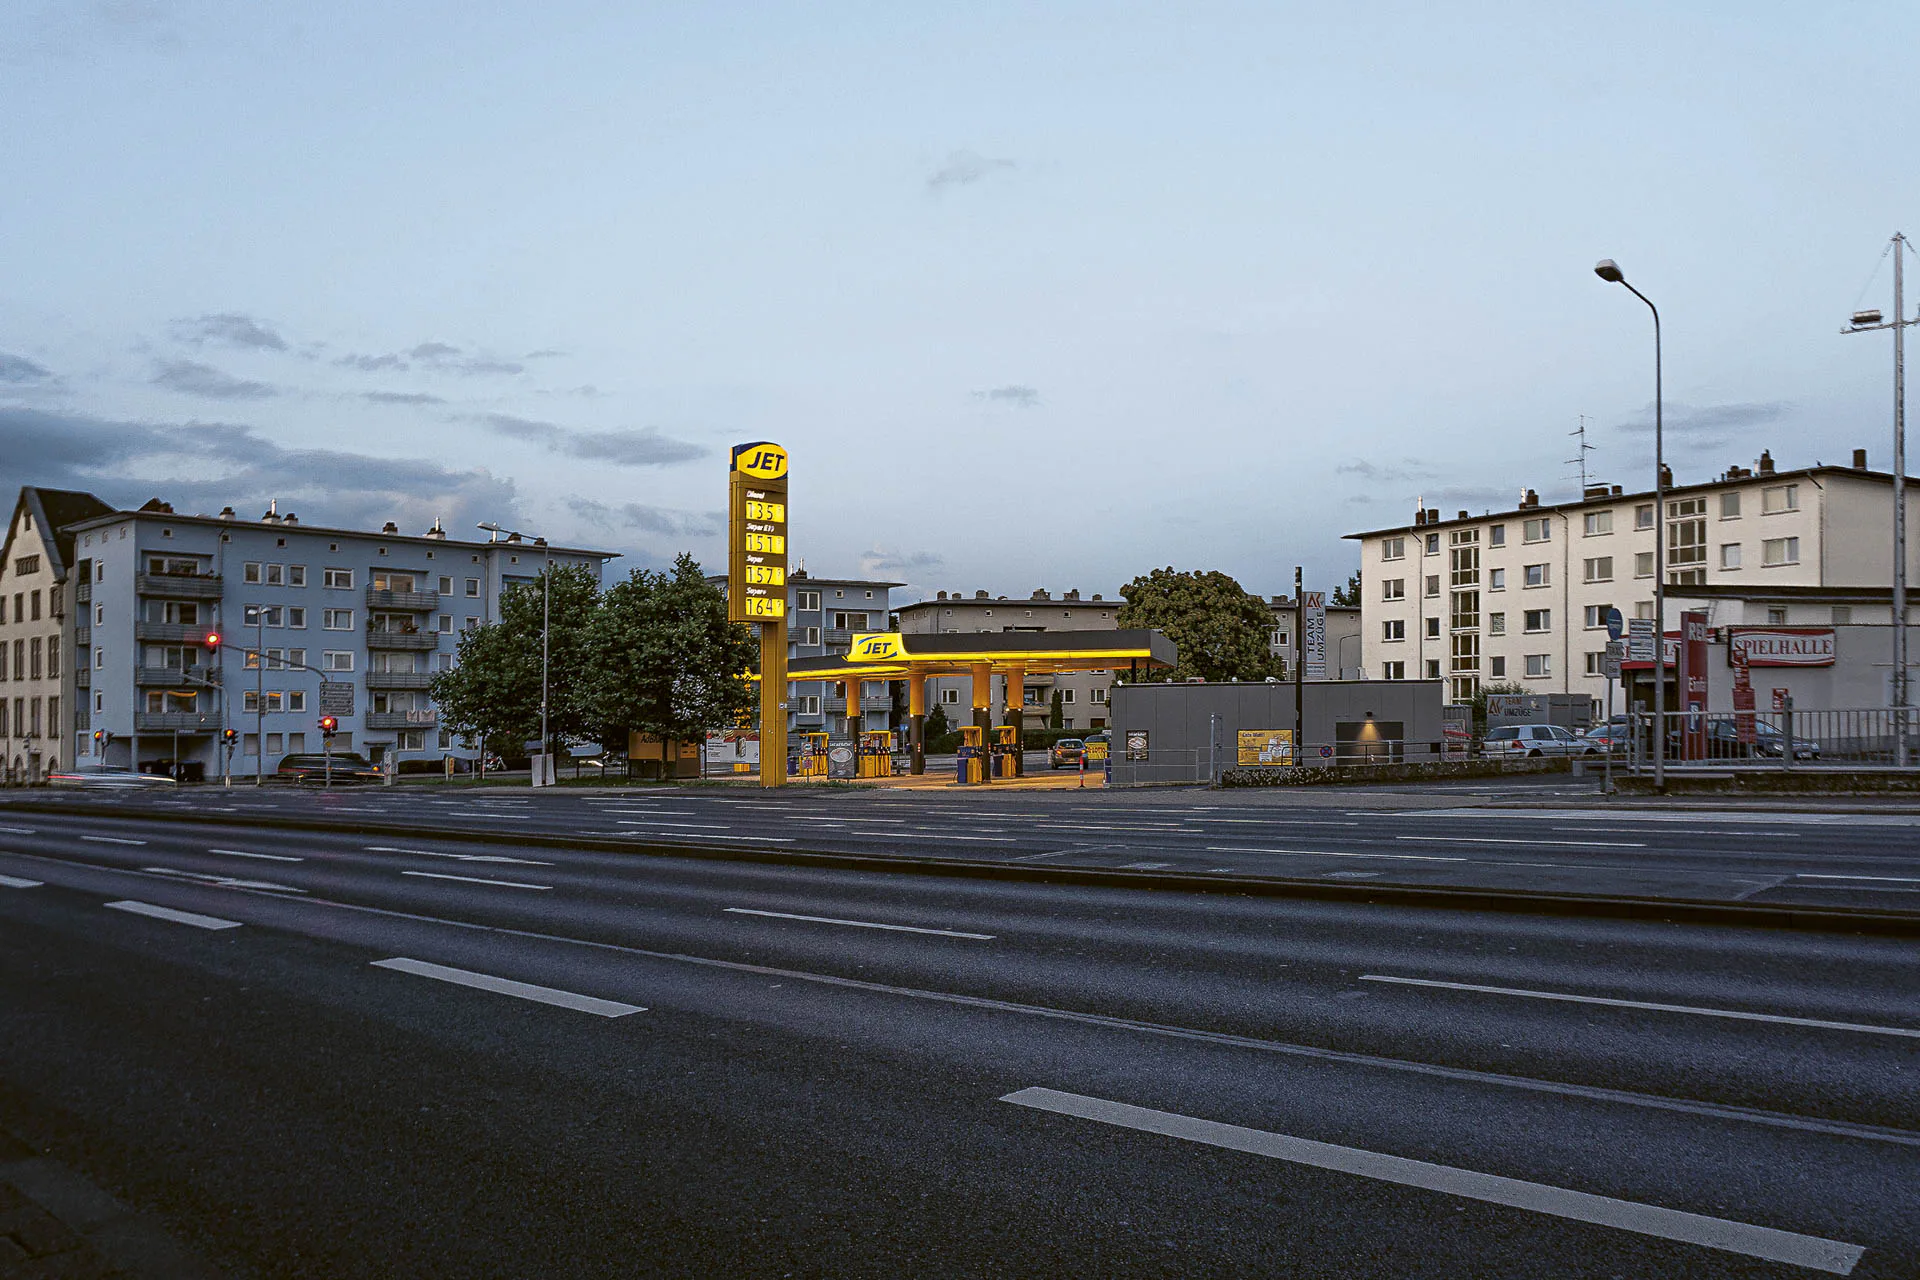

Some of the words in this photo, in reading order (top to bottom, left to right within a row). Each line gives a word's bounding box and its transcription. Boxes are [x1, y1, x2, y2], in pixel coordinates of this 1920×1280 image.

[747, 452, 785, 471] JET
[1307, 618, 1315, 654] TEAM
[1316, 611, 1325, 661] UMZÜGE
[863, 642, 892, 654] JET
[1734, 639, 1832, 655] SPIELHALLE
